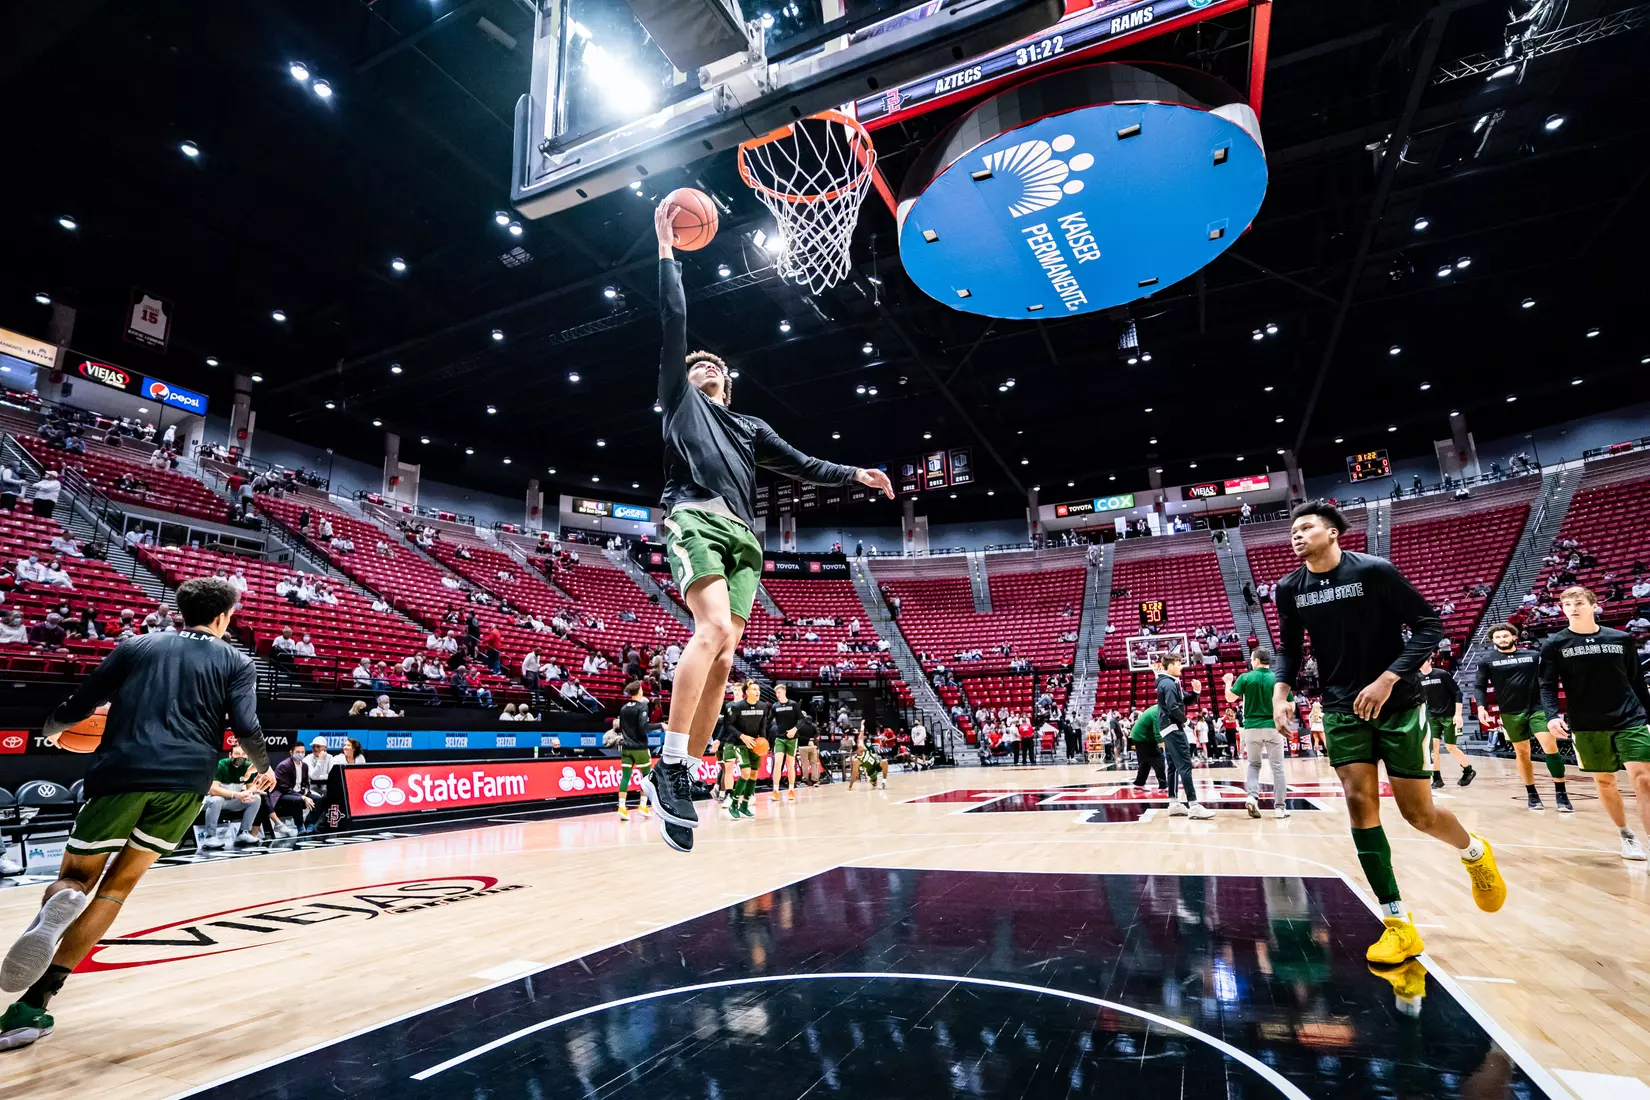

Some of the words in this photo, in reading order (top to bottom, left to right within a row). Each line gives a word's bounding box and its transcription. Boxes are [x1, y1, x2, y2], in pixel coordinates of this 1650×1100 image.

[1110, 7, 1154, 34] RAMS
[1016, 36, 1064, 66] 31:22
[935, 65, 982, 94] AZTECS
[1057, 211, 1101, 264] KAISER
[141, 309, 159, 324] 15
[27, 349, 53, 361] thrive
[86, 361, 124, 384] VIEJAS
[169, 392, 200, 407] pepsi
[1191, 486, 1214, 496] VIEJAS
[1069, 504, 1092, 512] TOYOTA
[1097, 496, 1131, 510] COX
[776, 563, 799, 571] TOYOTA
[822, 563, 846, 571] TOYOTA
[1335, 582, 1364, 600] STATE
[1147, 610, 1160, 622] 30
[179, 630, 216, 643] BLM
[386, 737, 412, 748] SELTZER
[445, 737, 468, 748] SELTZER
[98, 883, 474, 946] VIEJAS
